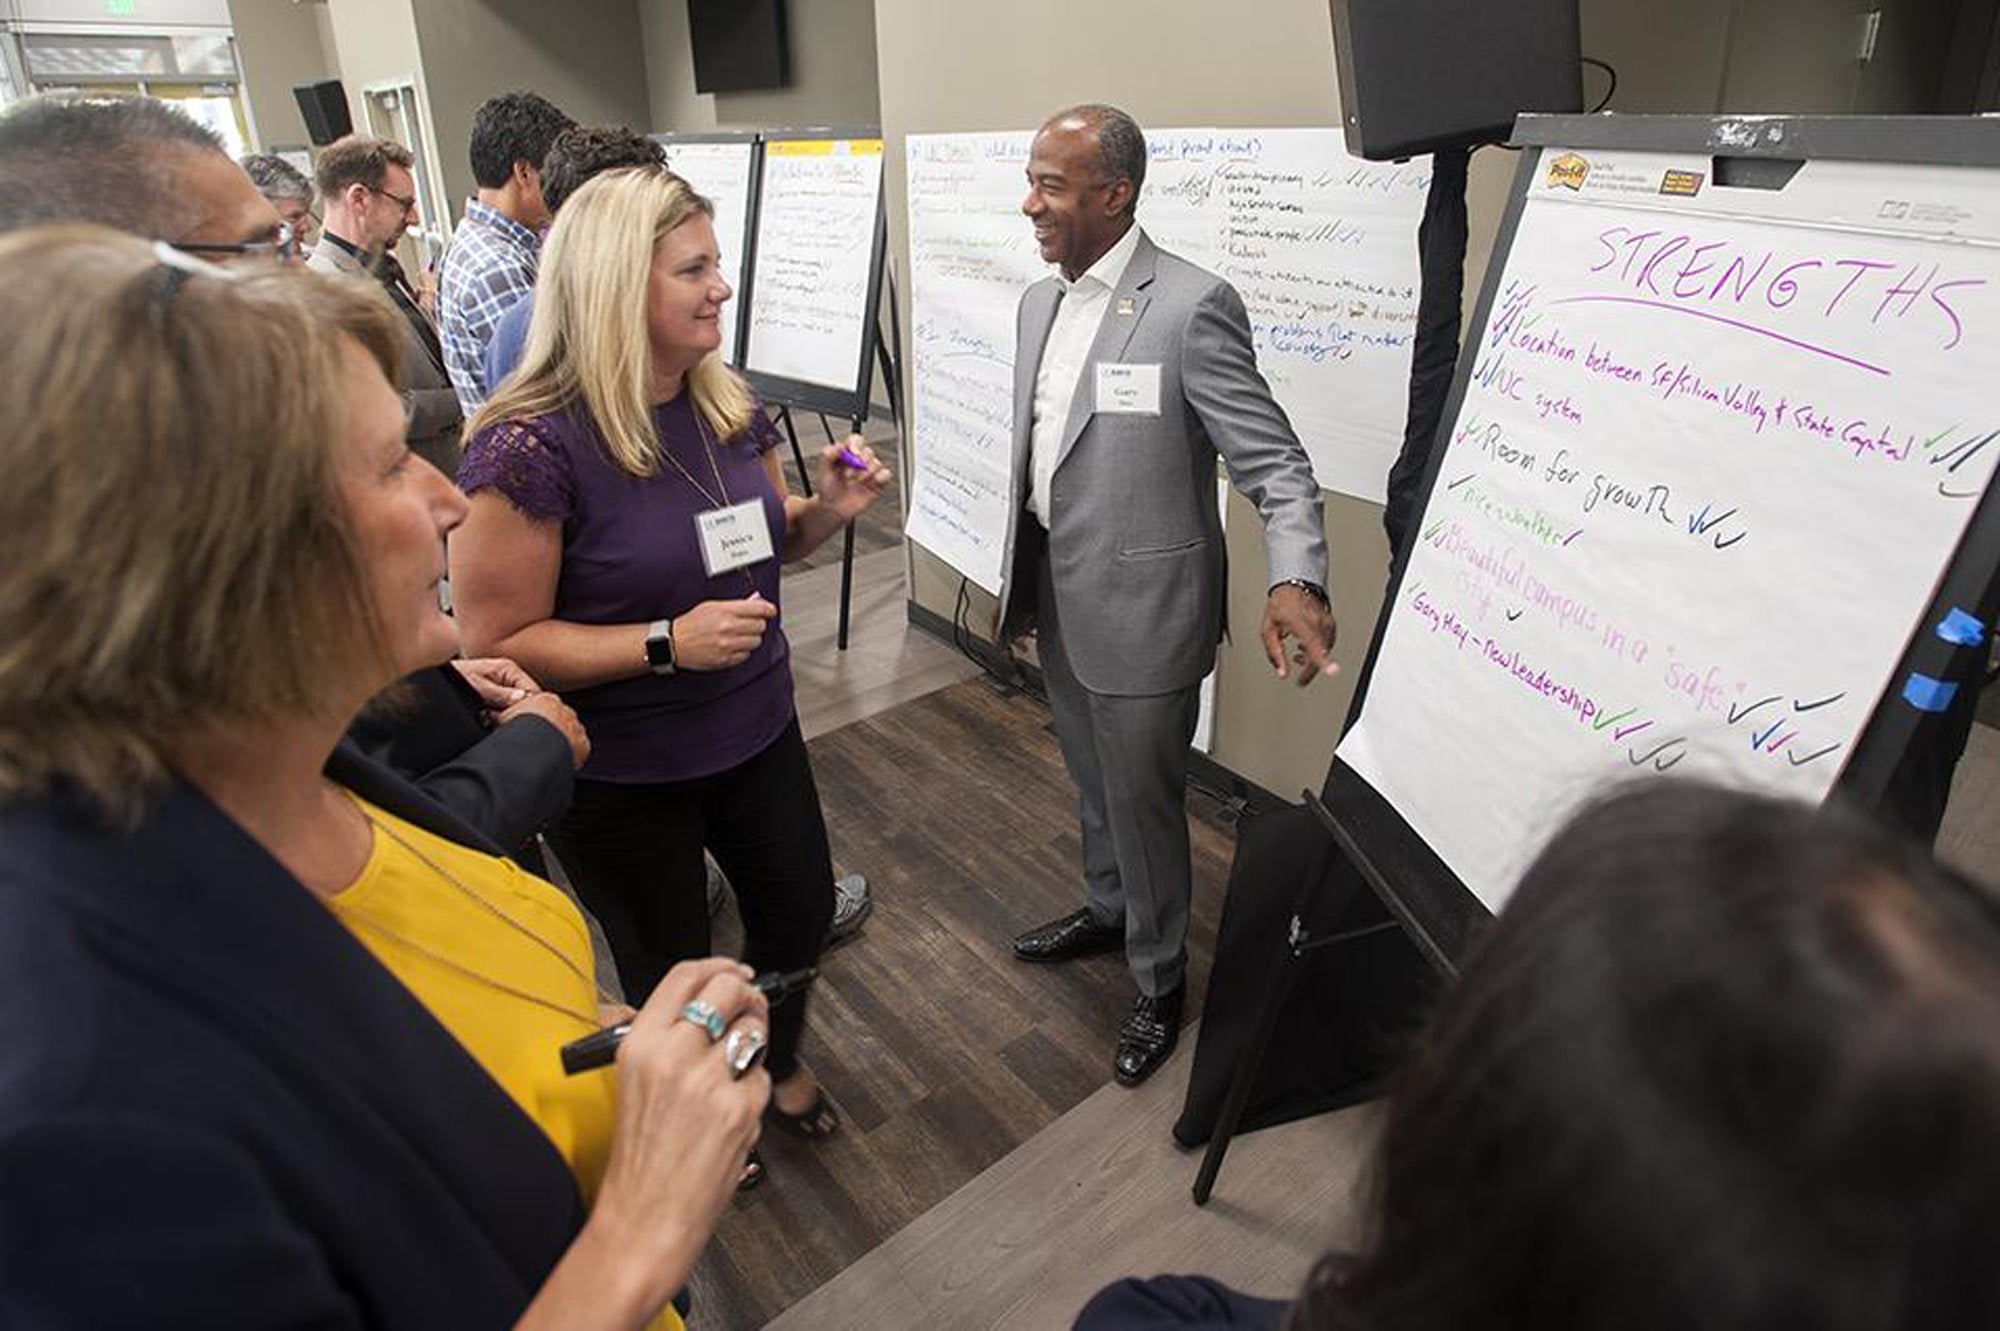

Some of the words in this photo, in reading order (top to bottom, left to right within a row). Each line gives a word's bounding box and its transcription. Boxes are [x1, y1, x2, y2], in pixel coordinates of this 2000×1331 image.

[1591, 226, 1987, 350] STRENGTHS
[1510, 316, 1575, 361] Location
[1585, 342, 1643, 382] between
[1725, 383, 1767, 434] Valley
[1536, 394, 1582, 423] system
[1482, 422, 1536, 471] Room
[1545, 449, 1580, 483] for
[1583, 475, 1674, 524] growth
